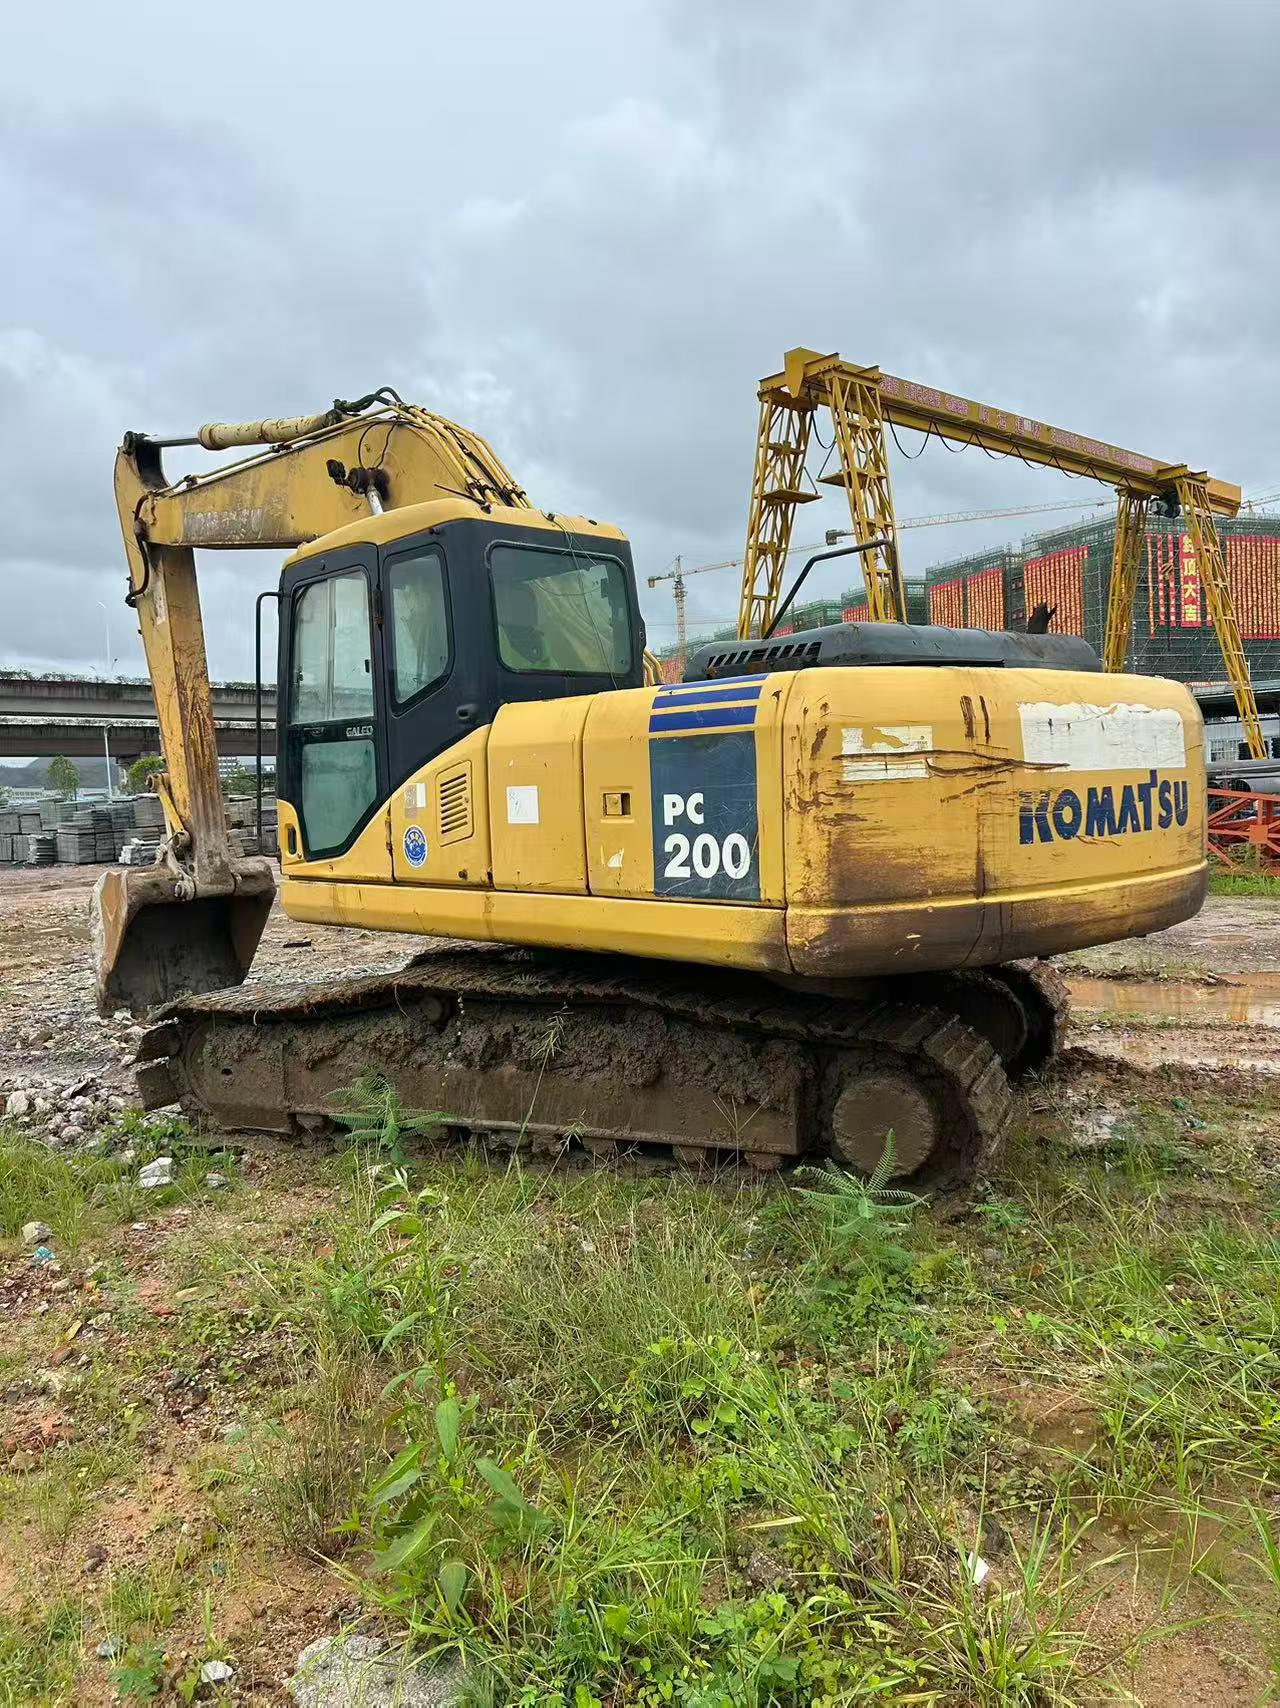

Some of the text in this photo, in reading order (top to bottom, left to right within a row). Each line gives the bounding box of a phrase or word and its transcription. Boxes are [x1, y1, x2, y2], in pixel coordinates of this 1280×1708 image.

[663, 792, 705, 826] PC
[1019, 769, 1189, 845] KOMATSU
[664, 832, 751, 880] 200
